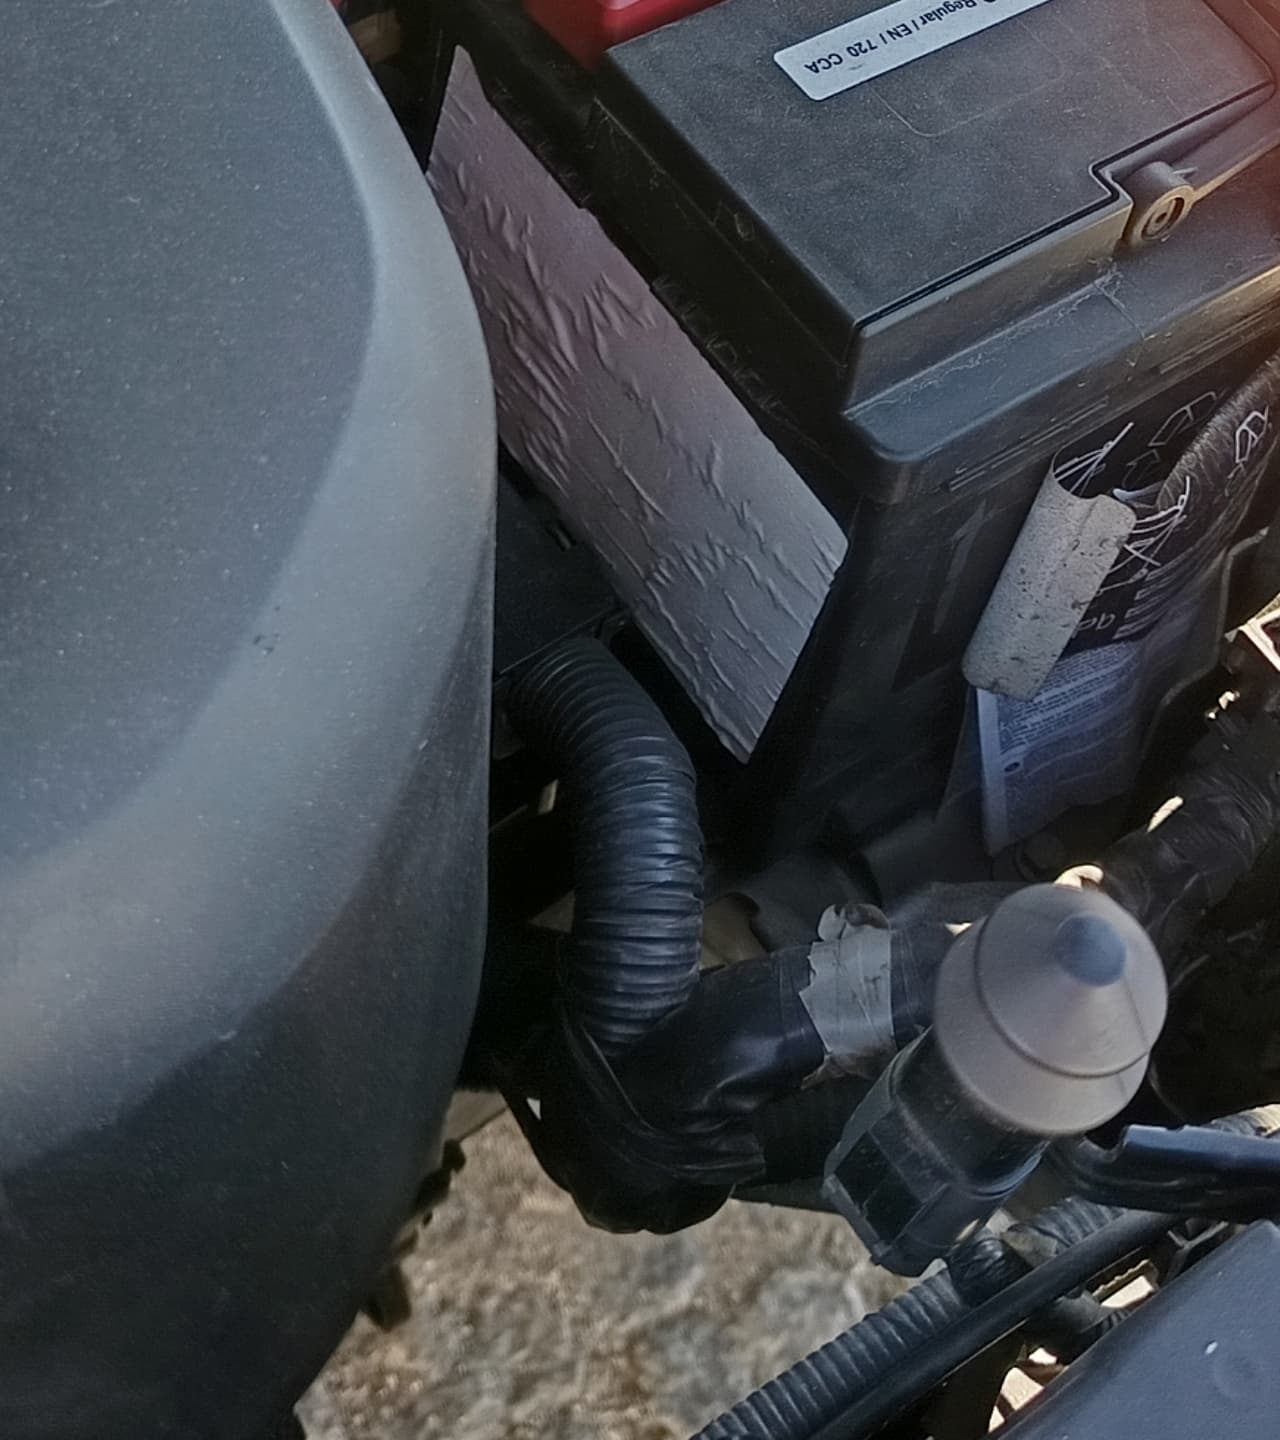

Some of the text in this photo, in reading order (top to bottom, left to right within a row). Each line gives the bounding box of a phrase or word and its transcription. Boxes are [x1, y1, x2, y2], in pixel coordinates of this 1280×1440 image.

[885, 22, 913, 41] EN
[845, 41, 880, 58] 720
[803, 52, 844, 74] CCA
